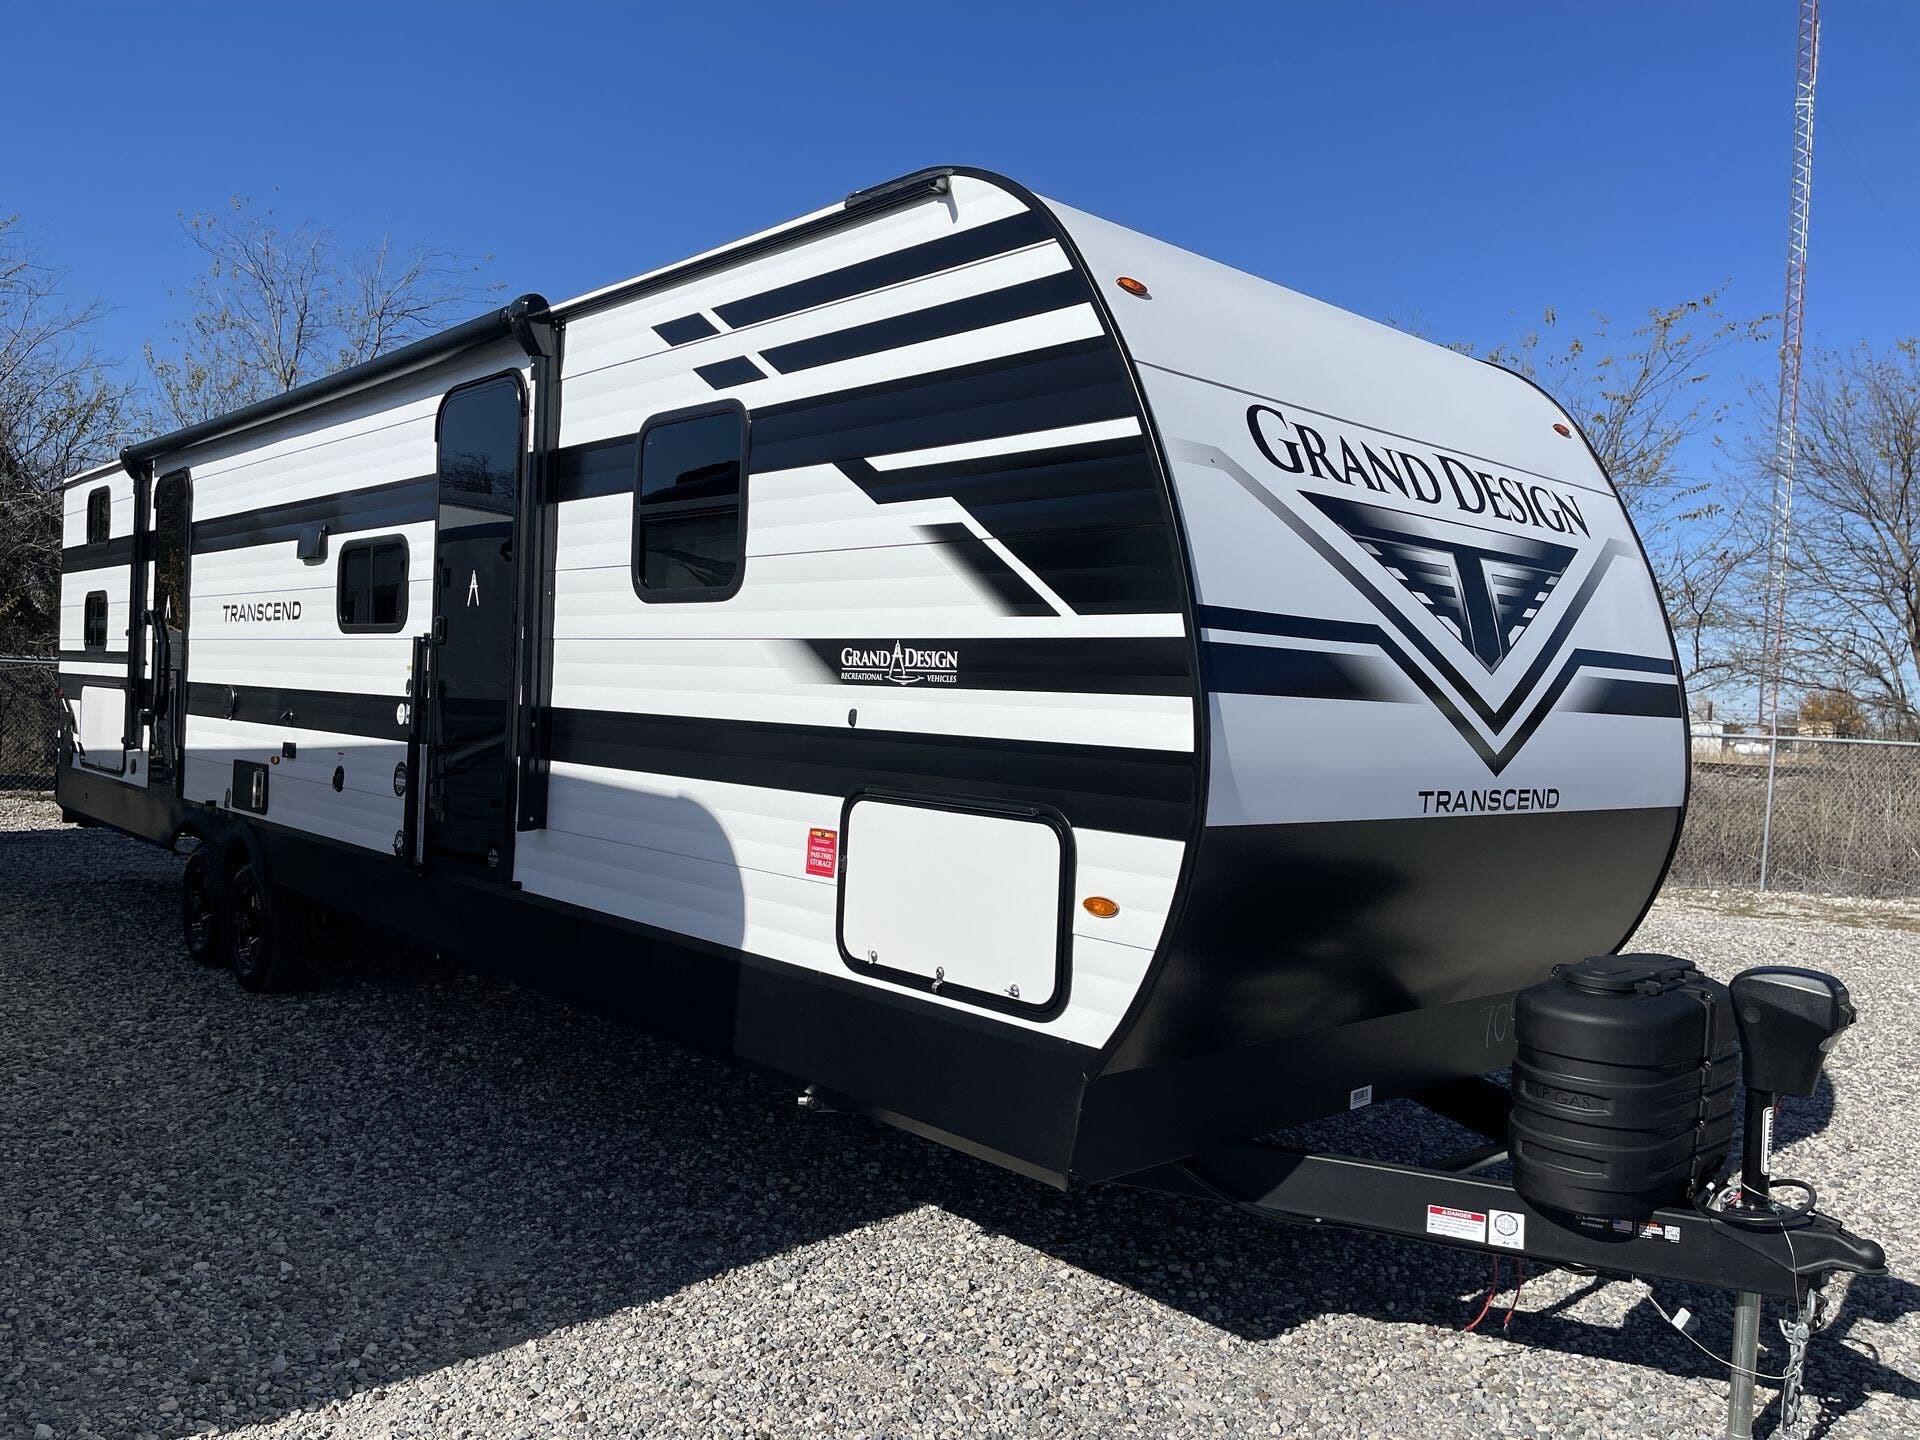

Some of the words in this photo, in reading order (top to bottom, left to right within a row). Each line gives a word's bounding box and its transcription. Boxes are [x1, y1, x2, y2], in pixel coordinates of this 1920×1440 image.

[1246, 403, 1442, 504] GRAND
[1432, 453, 1591, 539] DESIGN
[223, 601, 302, 622] TRANSCEND
[841, 647, 891, 667] GRAND
[903, 648, 958, 668] DESIGN
[841, 672, 883, 681] RECREATIONAL
[927, 675, 957, 683] VEHICLES
[1418, 788, 1560, 815] TRANSCEND
[1446, 1210, 1472, 1220] DANGER
